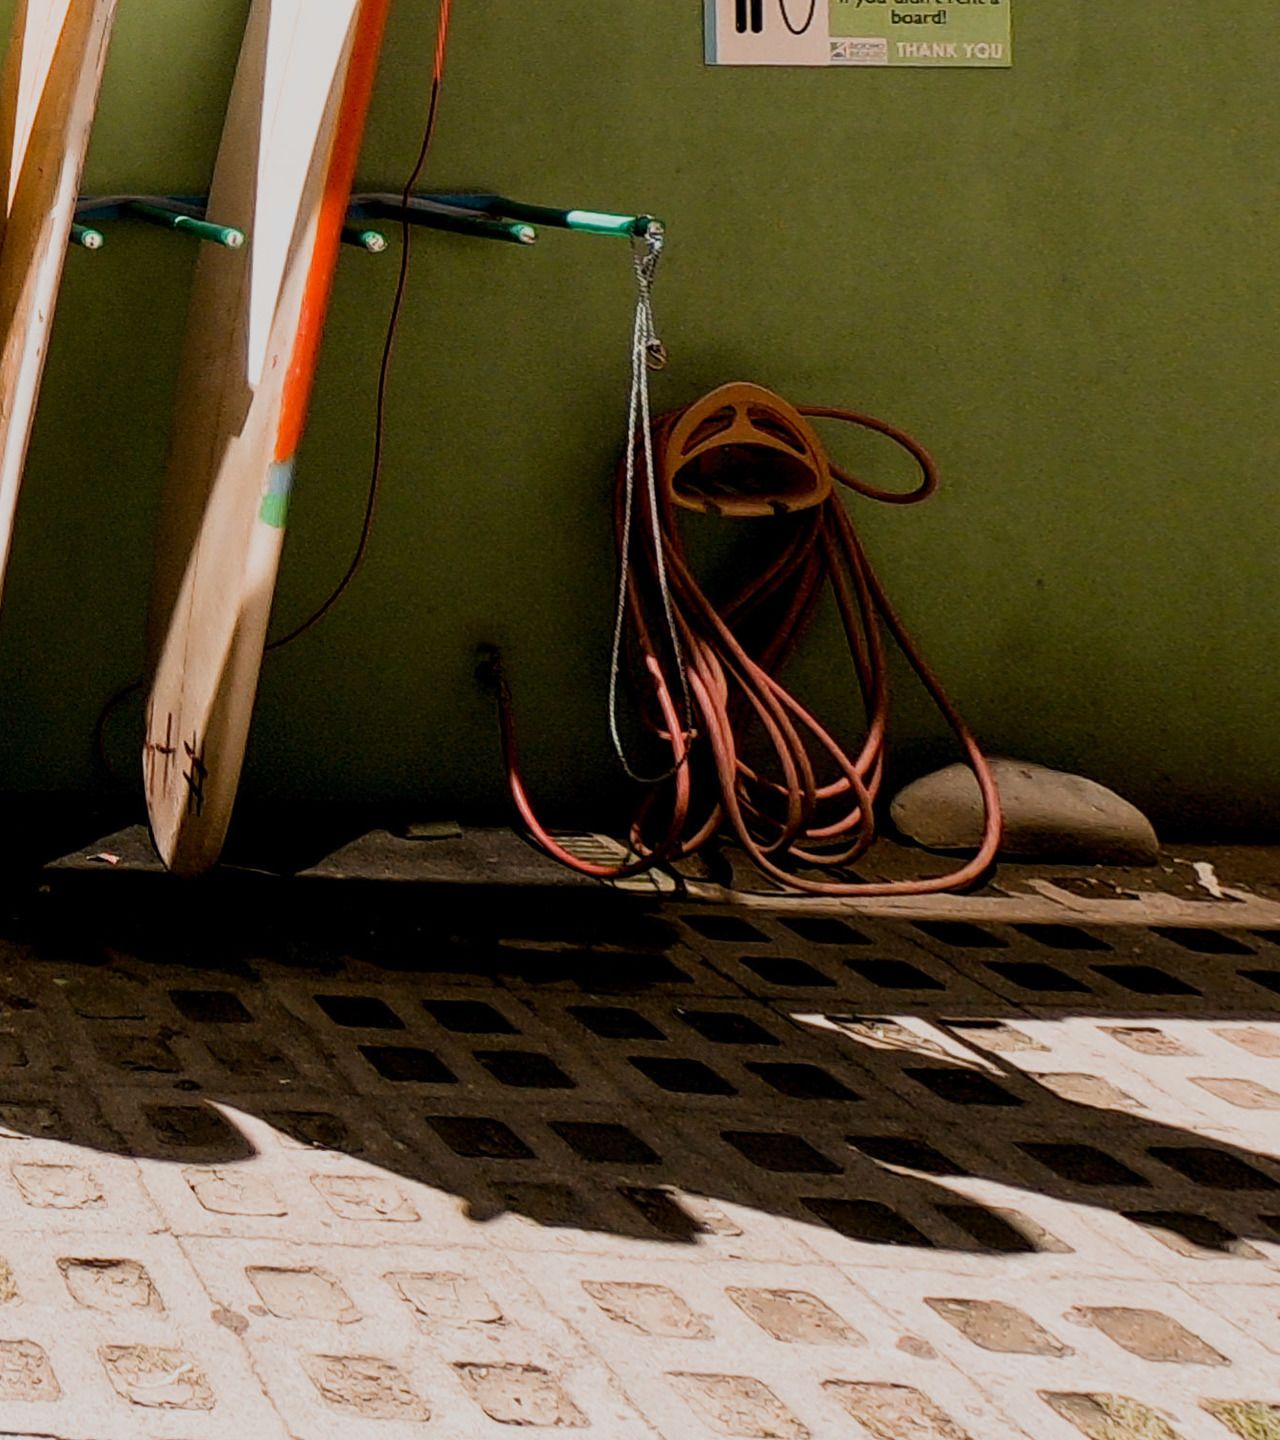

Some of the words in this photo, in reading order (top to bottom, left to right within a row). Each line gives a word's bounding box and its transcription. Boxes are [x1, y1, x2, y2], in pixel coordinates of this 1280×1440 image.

[891, 9, 947, 25] board!
[896, 41, 958, 58] THANK
[963, 41, 1003, 59] YOU
